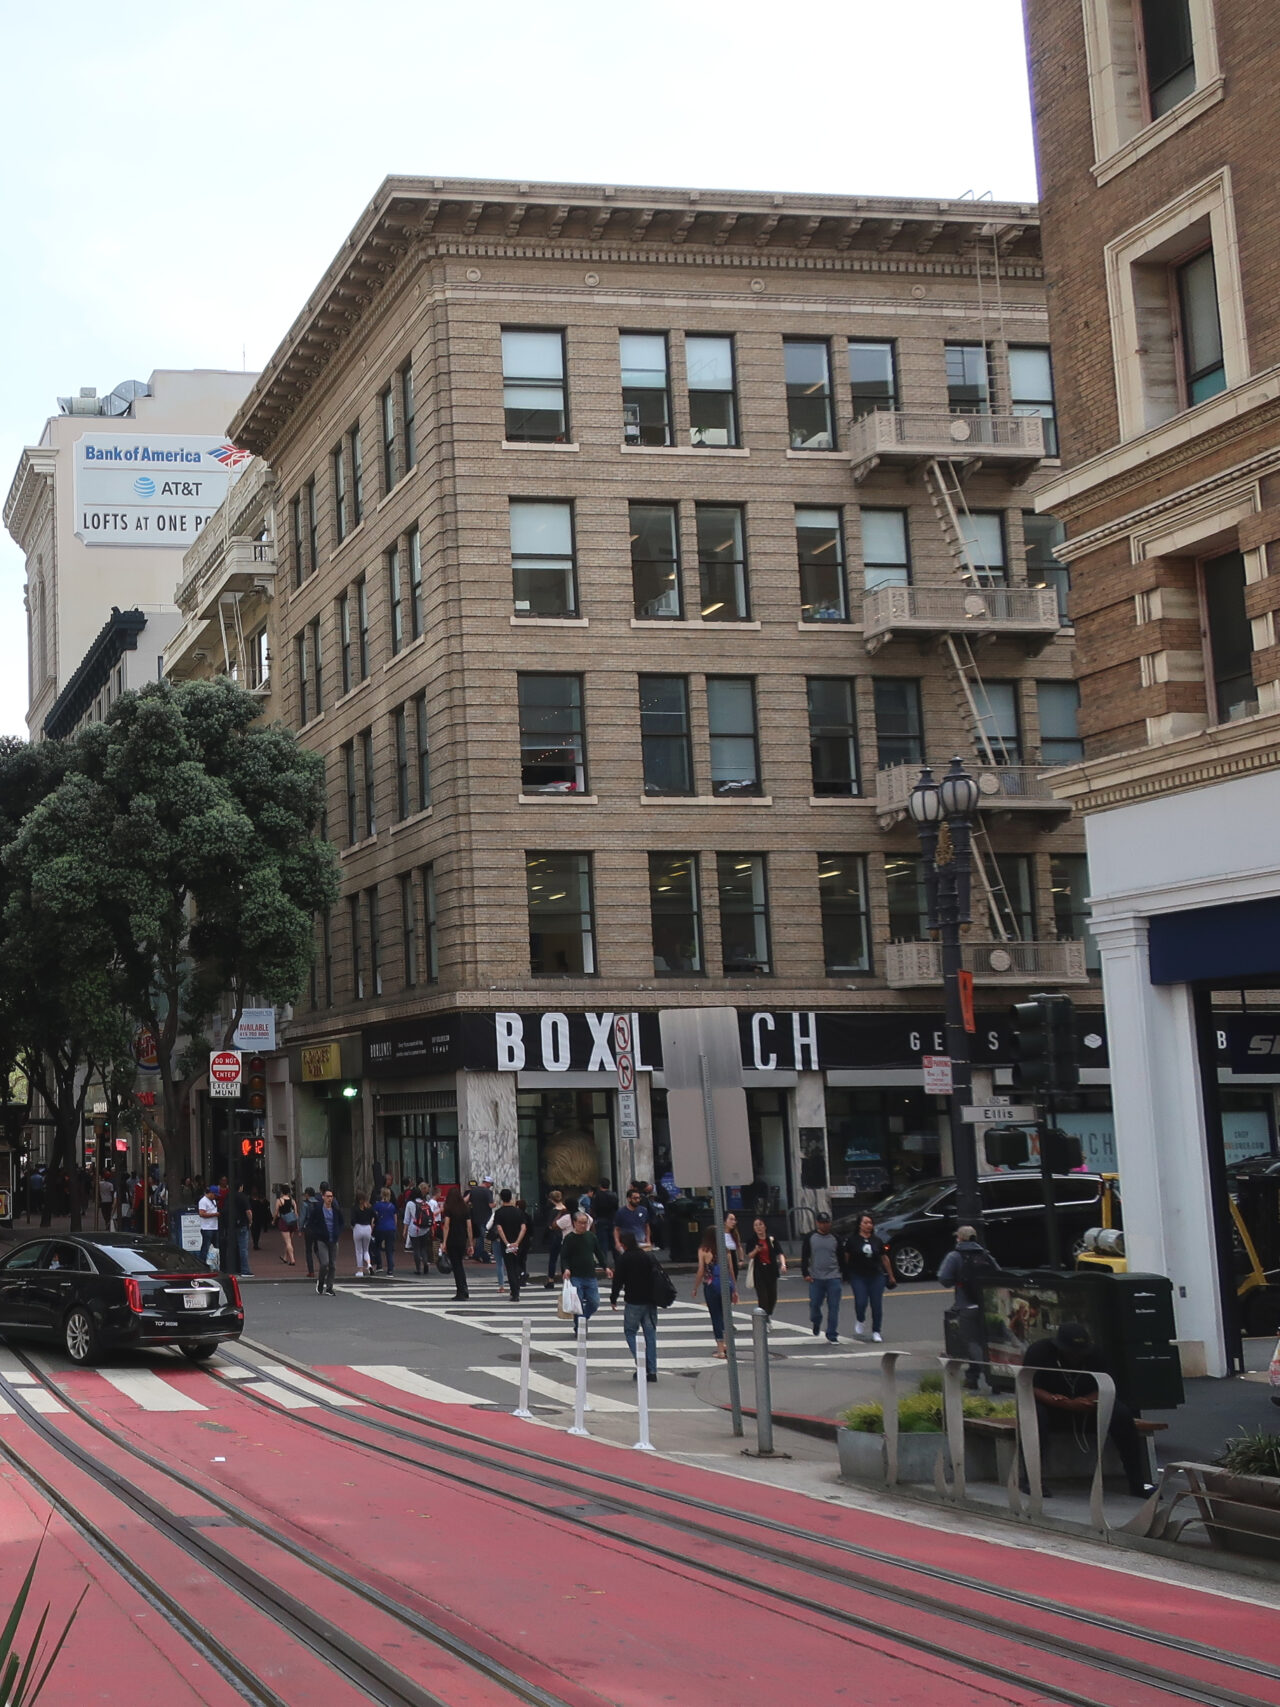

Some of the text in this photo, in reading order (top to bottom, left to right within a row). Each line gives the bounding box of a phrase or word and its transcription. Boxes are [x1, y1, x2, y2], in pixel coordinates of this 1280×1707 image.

[85, 445, 201, 463] Bank of America
[161, 481, 202, 496] AT&T
[83, 512, 128, 530] LOFTS
[135, 516, 150, 531] AT
[157, 515, 187, 532] ONE
[239, 1023, 269, 1031] AVAILABLE
[495, 1012, 819, 1071] BOXLCH
[984, 1109, 1014, 1119] Ellis
[255, 1140, 263, 1154] 12
